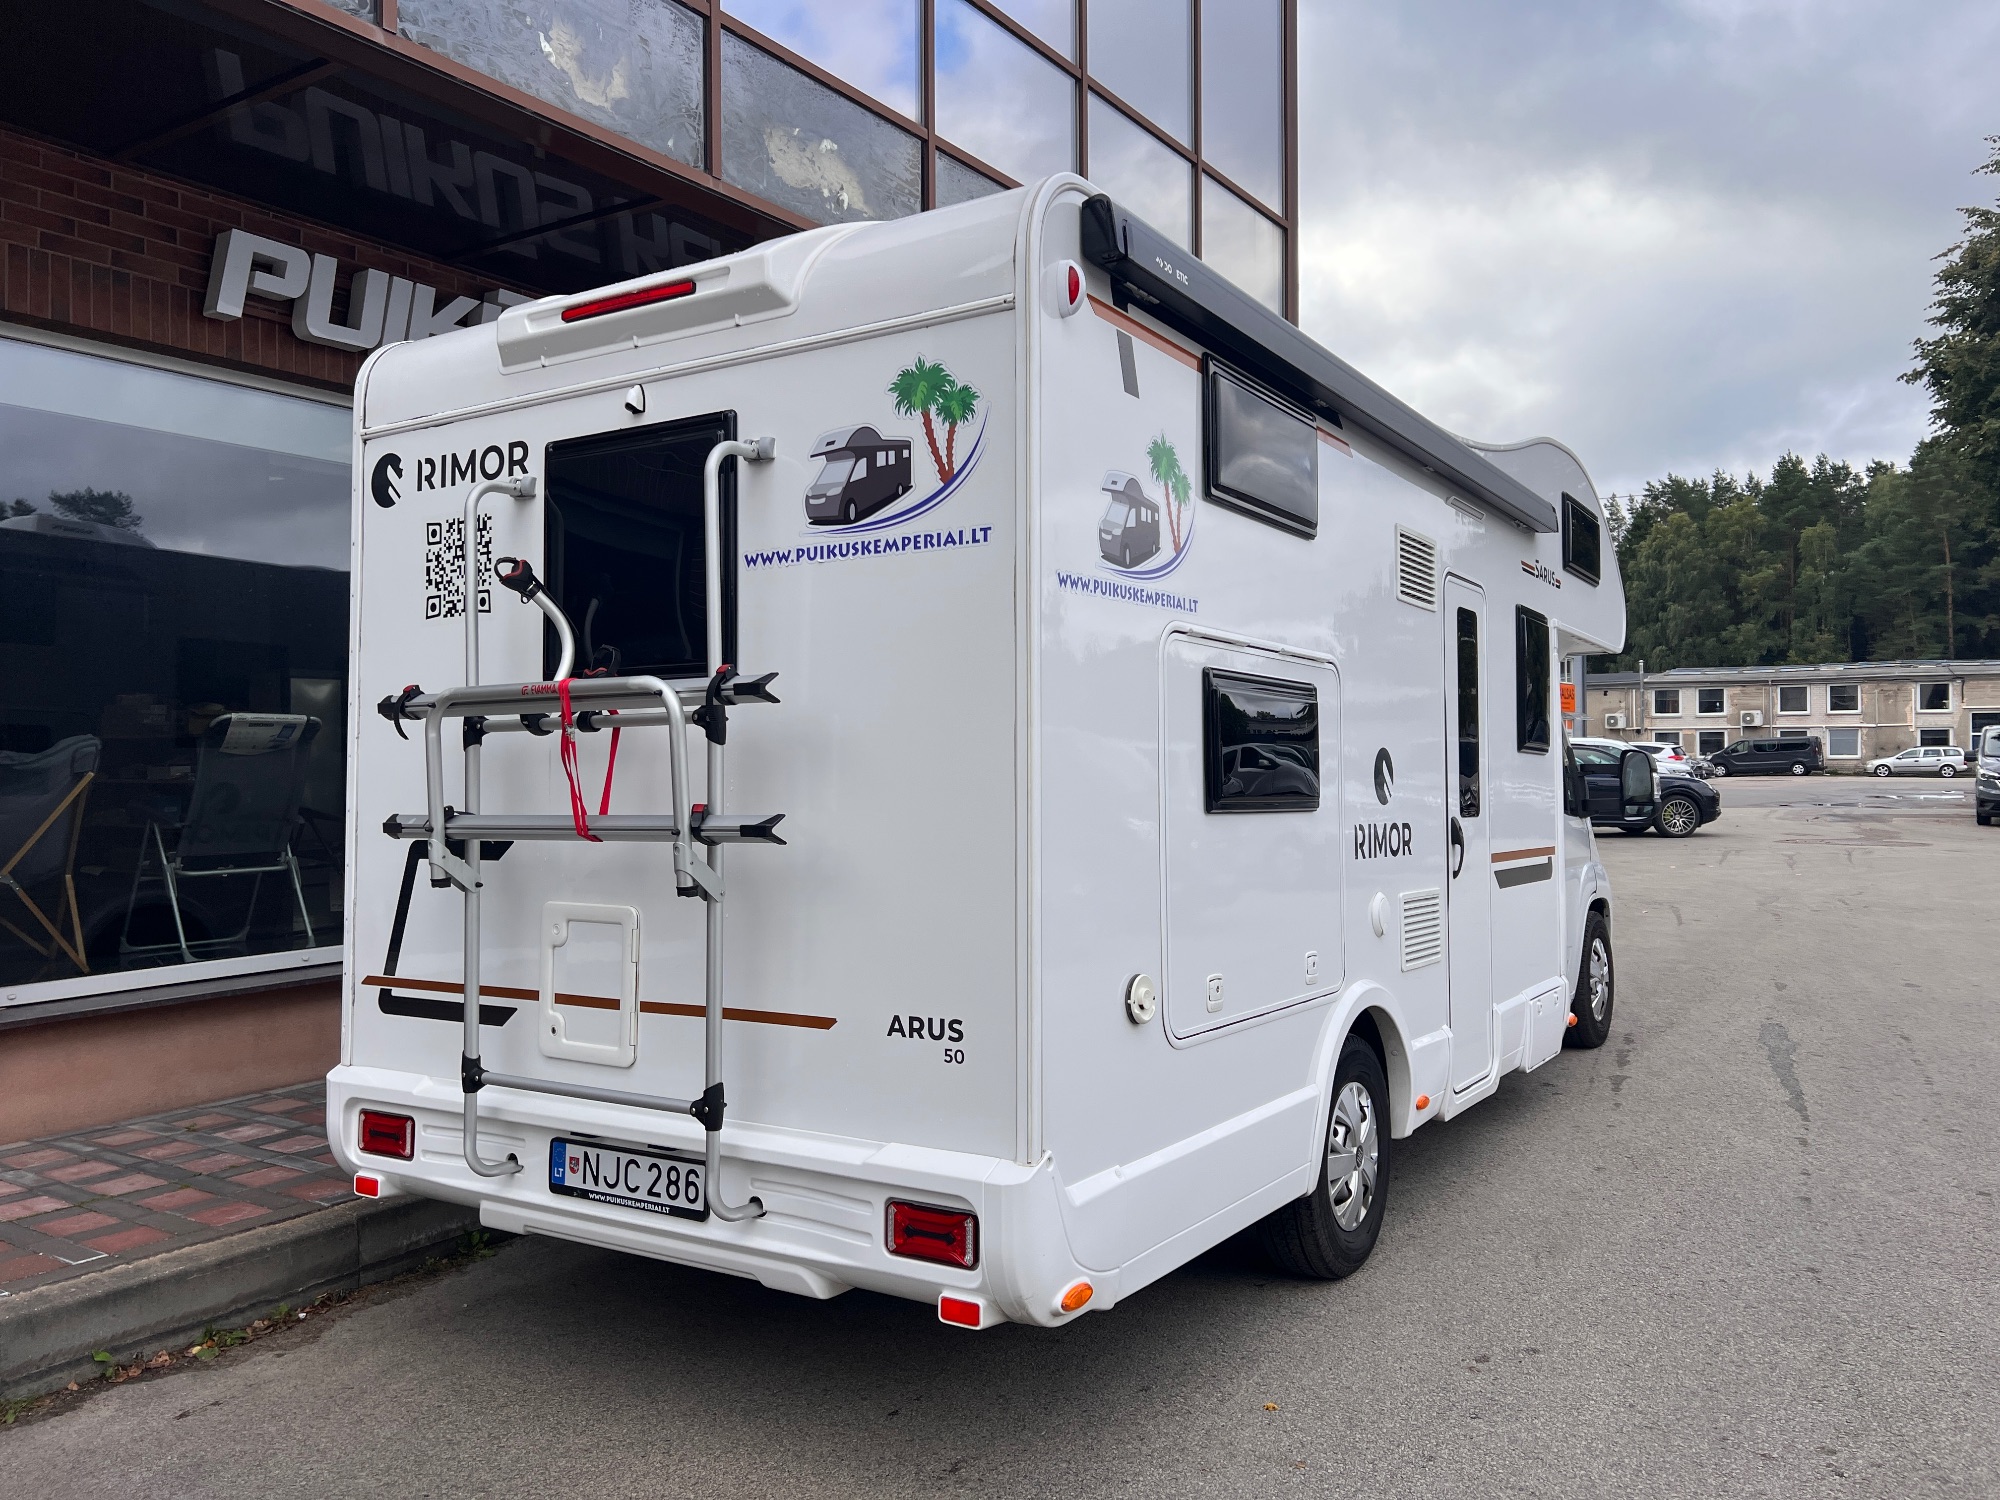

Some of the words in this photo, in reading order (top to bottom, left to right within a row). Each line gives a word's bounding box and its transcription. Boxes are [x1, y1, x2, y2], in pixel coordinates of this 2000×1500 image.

[203, 228, 537, 353] PUIK
[417, 440, 530, 492] RIMOR
[744, 526, 992, 568] WWW.PUIKUSKEMPERIAI.LT
[1057, 572, 1199, 613] WWW.PUIKUSKEMPERIAI.LT
[1354, 822, 1413, 860] RIMOR
[886, 1014, 964, 1043] ARUS
[943, 1048, 965, 1065] 50
[554, 1167, 564, 1178] LT
